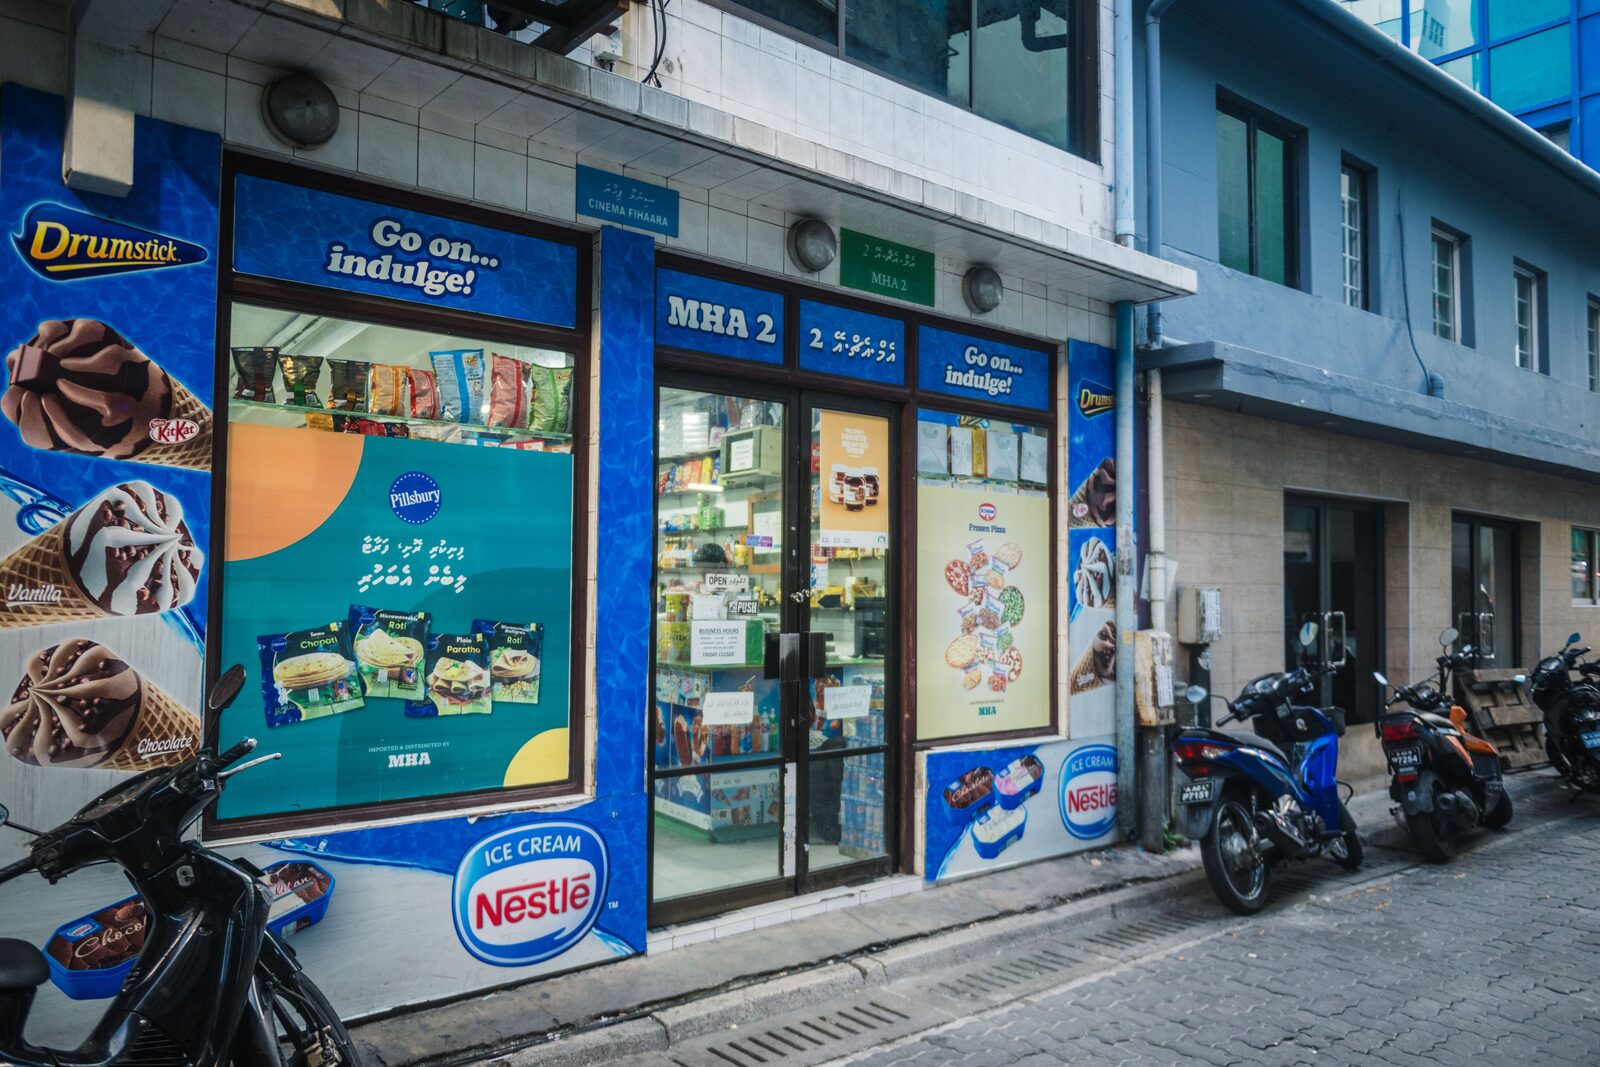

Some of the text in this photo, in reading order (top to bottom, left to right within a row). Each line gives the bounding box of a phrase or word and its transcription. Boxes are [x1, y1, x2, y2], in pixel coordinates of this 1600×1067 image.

[588, 198, 669, 227] CINEMA FIHAARA
[30, 220, 178, 261] Drumstick
[372, 220, 499, 268] Go on...
[327, 245, 476, 296] indulge!
[871, 271, 908, 292] MHA 2
[668, 295, 777, 344] MHA 2
[809, 327, 825, 350] 2
[964, 346, 1024, 375] Go on...
[945, 364, 1013, 397] indulge!
[1080, 388, 1115, 409] Drums
[157, 420, 195, 443] KitKat
[390, 489, 441, 509] Pillsbury
[968, 523, 1006, 534] Frozen Pizza
[708, 576, 728, 586] OPEN
[8, 583, 62, 602] Vanilla
[737, 600, 758, 614] PUSH
[388, 621, 407, 630] Roti
[300, 636, 338, 649] Chapati
[446, 645, 481, 654] Paratha
[456, 636, 473, 644] Plain
[506, 636, 523, 644] Roti
[978, 706, 997, 716] MHA
[137, 735, 193, 755] Chocolate
[388, 752, 431, 768] MHA
[1071, 755, 1114, 773] ICE CREAM
[484, 834, 582, 867] ICE CREAM
